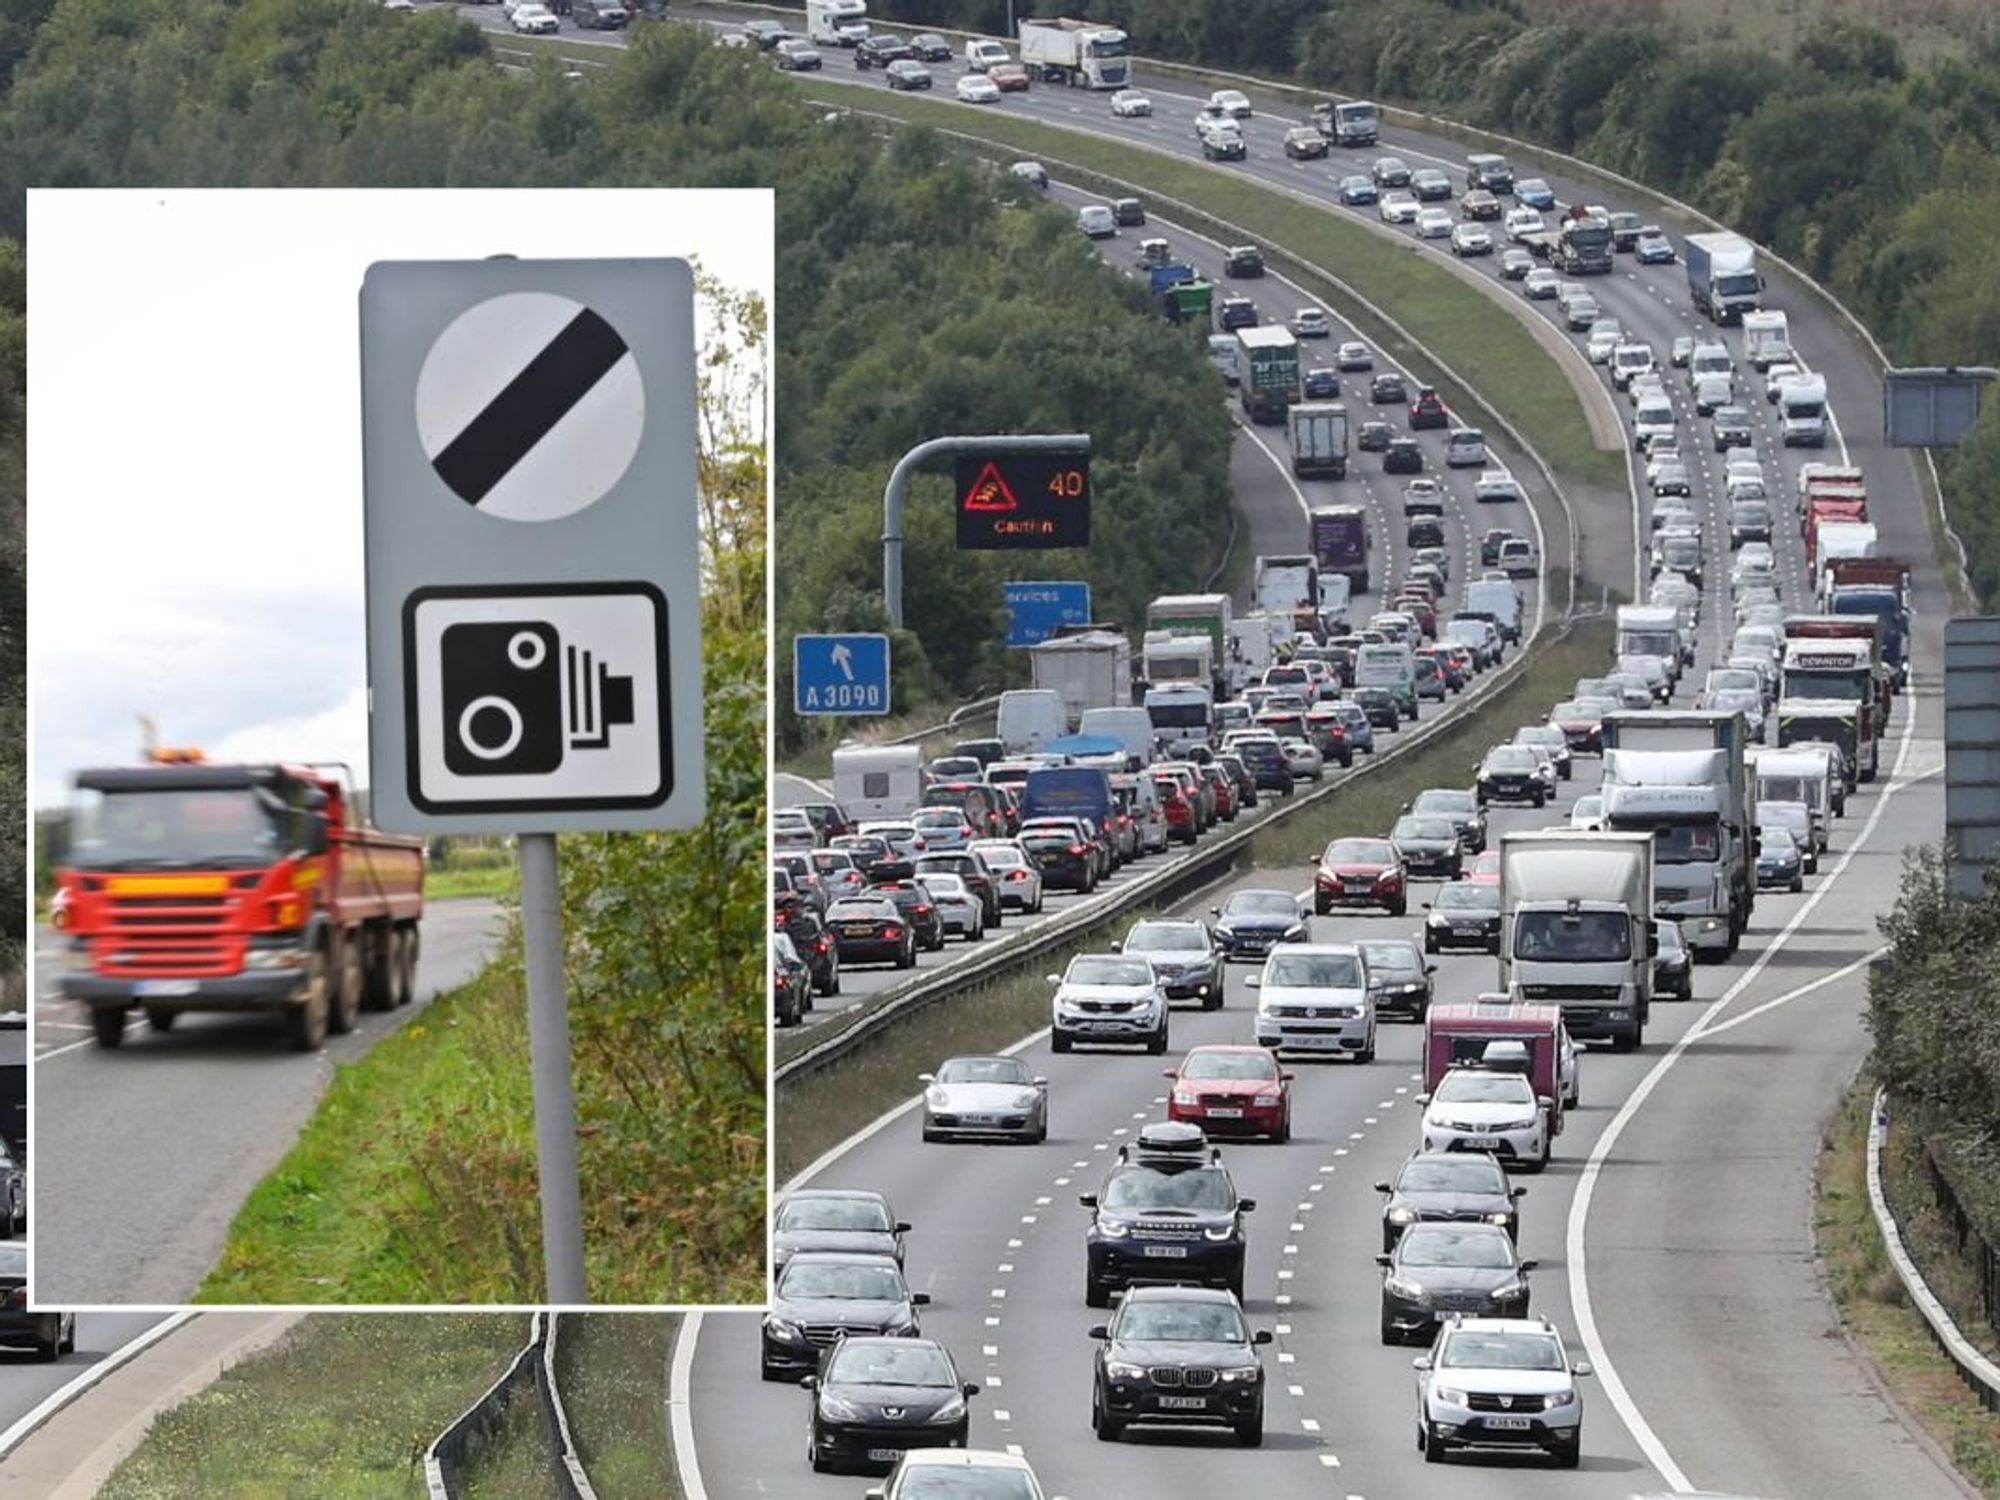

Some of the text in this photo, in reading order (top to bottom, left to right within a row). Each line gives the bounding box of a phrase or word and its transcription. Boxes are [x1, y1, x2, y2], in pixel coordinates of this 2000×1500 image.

[1048, 470, 1084, 497] 40
[1004, 590, 1060, 602] ervices
[806, 686, 880, 708] A 3090
